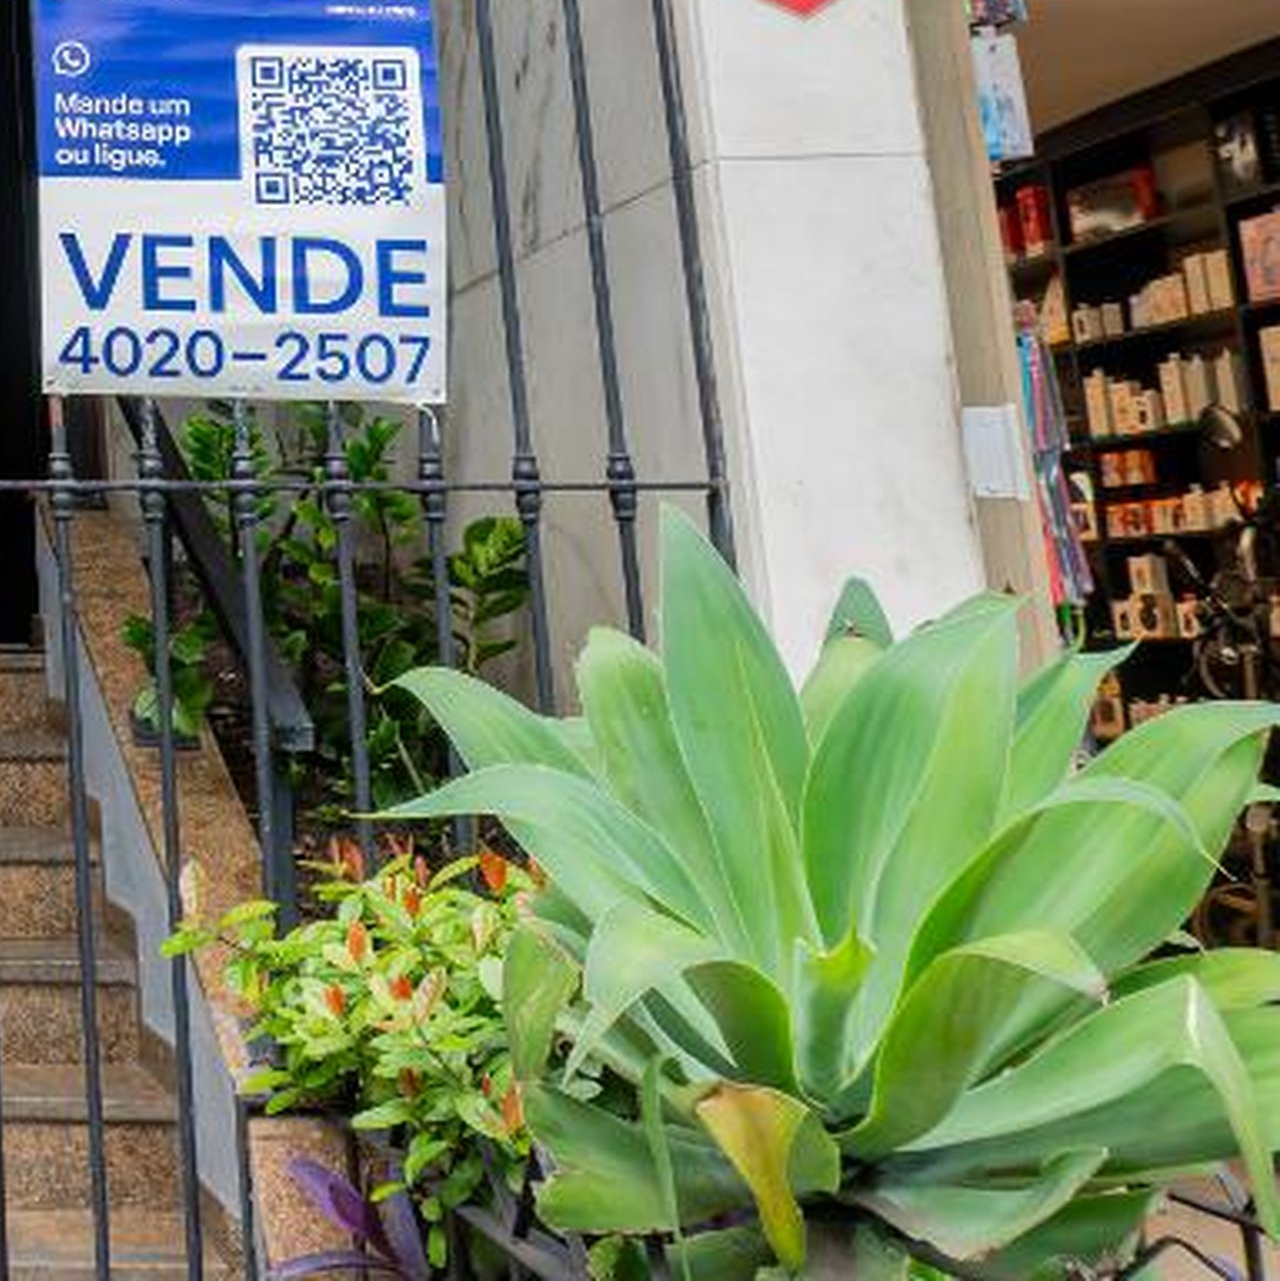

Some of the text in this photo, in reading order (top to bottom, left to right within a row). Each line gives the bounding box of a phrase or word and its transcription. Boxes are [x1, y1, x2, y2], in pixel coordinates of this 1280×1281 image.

[54, 93, 191, 116] Mande um
[54, 118, 192, 147] Whatsapp
[54, 144, 167, 170] ou ligue.
[58, 231, 431, 318] VENDE
[57, 325, 432, 385] 4020-2507
